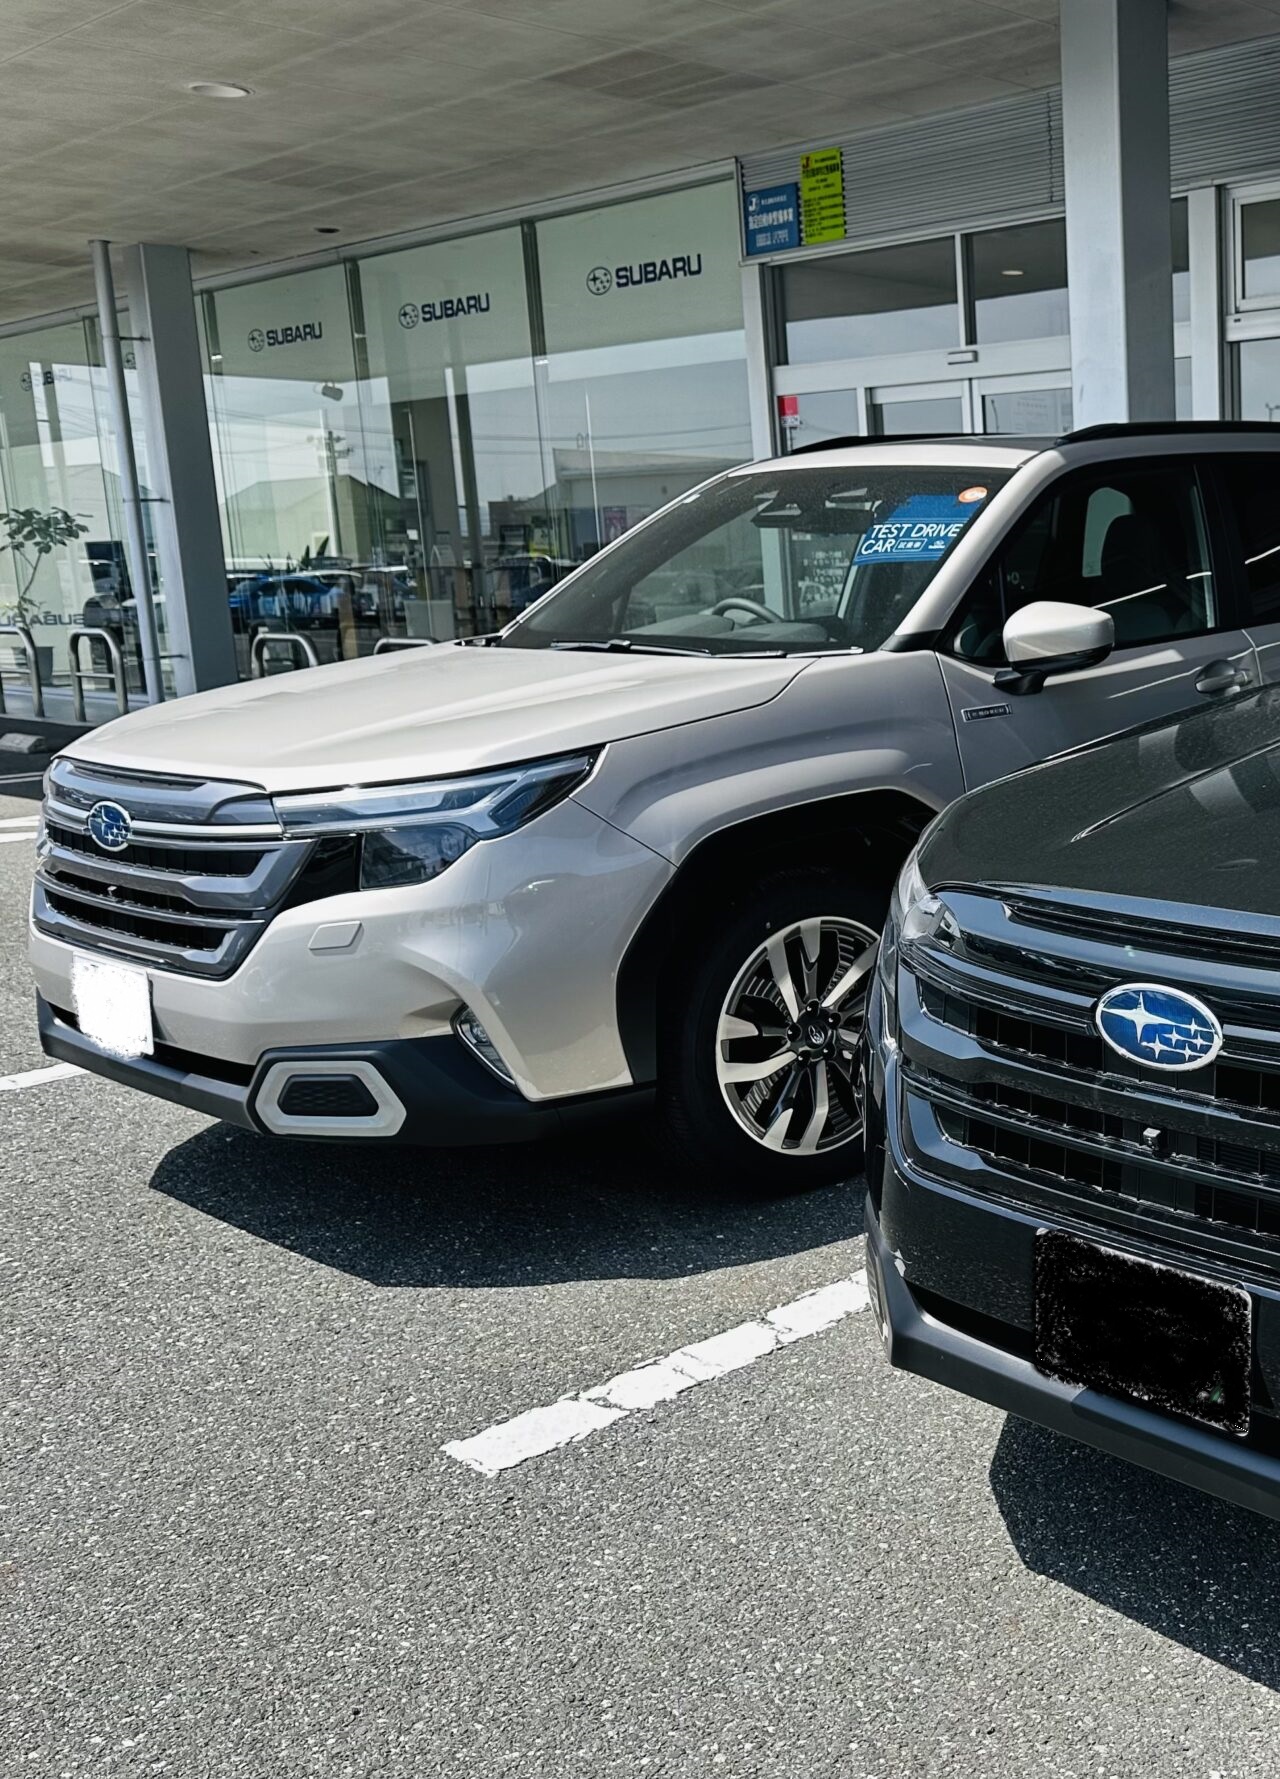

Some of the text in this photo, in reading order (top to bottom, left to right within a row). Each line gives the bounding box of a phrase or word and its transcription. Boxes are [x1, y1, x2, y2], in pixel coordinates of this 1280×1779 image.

[615, 253, 702, 288] SUBARU
[420, 293, 490, 323] SUBARU
[266, 321, 323, 347] SUBARU
[871, 523, 964, 539] TEST DRIVE
[861, 539, 896, 555] CAR
